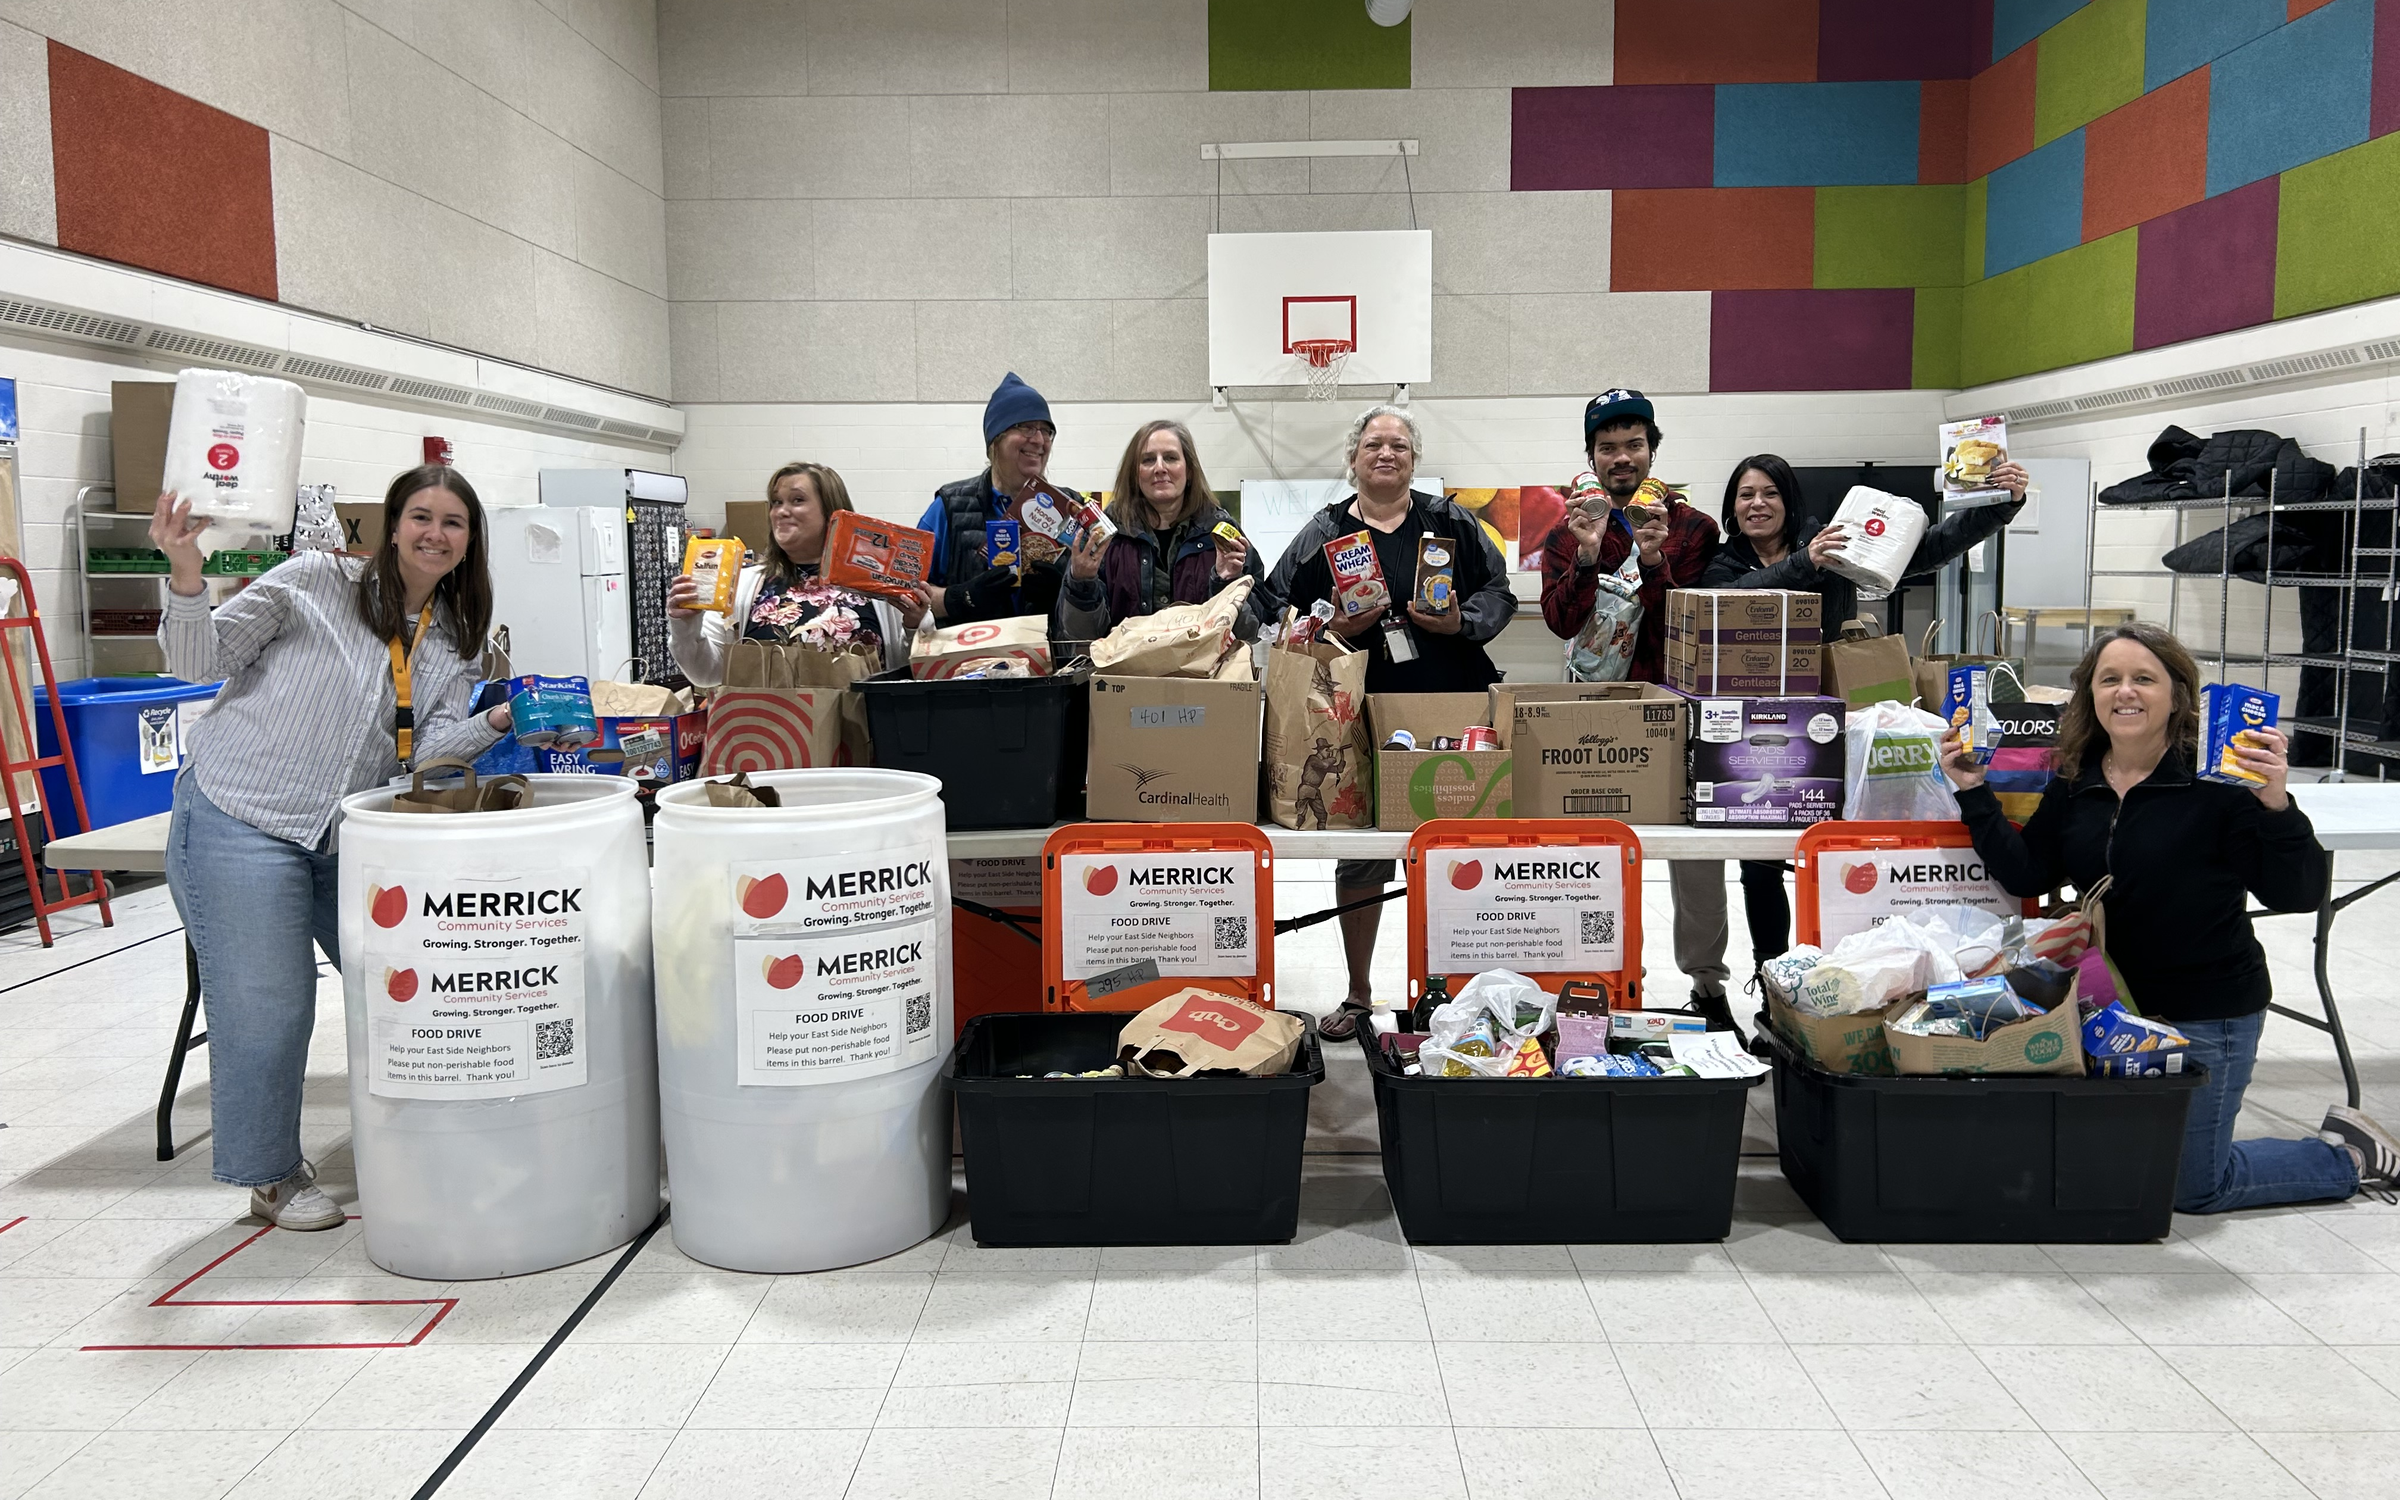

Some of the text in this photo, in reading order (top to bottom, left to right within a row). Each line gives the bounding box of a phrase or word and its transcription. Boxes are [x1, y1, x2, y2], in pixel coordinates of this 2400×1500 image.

[1028, 512, 1041, 525] Nut
[1034, 506, 1056, 526] Honey
[346, 519, 362, 544] X
[873, 533, 890, 549] 12
[900, 552, 919, 562] Soup
[1334, 545, 1370, 562] CREAM
[894, 559, 922, 570] Noodle
[1337, 554, 1372, 572] WHEAT
[872, 573, 911, 588] Maruchan
[1796, 608, 1812, 618] 20
[1736, 631, 1781, 641] Gentleas
[1793, 658, 1809, 667] 20
[539, 681, 576, 689] StarKist
[1112, 685, 1125, 693] TOP
[1229, 683, 1252, 692] FRAGILE
[150, 707, 171, 716] Recycle
[1140, 708, 1197, 724] 401 HP
[1646, 710, 1673, 721] 11789
[1645, 728, 1668, 738] 10040
[1542, 747, 1649, 765] FROOT LOOPS
[1749, 746, 1786, 754] PADS
[550, 754, 580, 764] EASY
[1728, 756, 1806, 765] SERVIETTES
[552, 765, 596, 774] WRING
[680, 762, 694, 778] EASY
[1414, 783, 1476, 794] possibilities
[1437, 795, 1476, 805] endless
[1799, 789, 1825, 801] 144
[1129, 867, 1234, 885] MERRICK
[1494, 862, 1601, 880] MERRICK
[806, 860, 932, 900] MERRICK
[1505, 881, 1591, 890] Community Services
[1140, 888, 1187, 896] Community
[1900, 883, 1990, 894] Community Services
[423, 888, 582, 918] MERRICK
[822, 889, 925, 913] Community Services
[1164, 900, 1198, 908] Stronger.
[1925, 898, 1961, 906] Stronger.
[1962, 897, 2000, 905] Together.
[803, 900, 933, 928] Growing. Stronger. Together.
[437, 918, 568, 933] Community Services
[1111, 917, 1171, 926] FOOD DRIVE
[423, 935, 581, 951] Growing. Stronger. Together.
[431, 965, 559, 993] MERRICK
[1098, 974, 1121, 993] 295
[1804, 981, 1831, 996] Total
[443, 989, 548, 1004] Community Services
[1811, 993, 1839, 1008] Wine
[432, 1003, 560, 1019] Growing. Stronger. Together.
[795, 1008, 864, 1024] FOOD DRIVE
[1188, 1011, 1241, 1031] Cub
[1647, 1018, 1665, 1026] Chex
[411, 1028, 482, 1039] FOOD DRIVE
[389, 1044, 511, 1056] Help your East Side Neighbors
[2027, 1038, 2060, 1051] WHOLE
[2030, 1047, 2060, 1057] FOODS
[388, 1057, 514, 1071] Please put non-perishable food
[388, 1070, 515, 1082] items in this barrel. Thank you!
